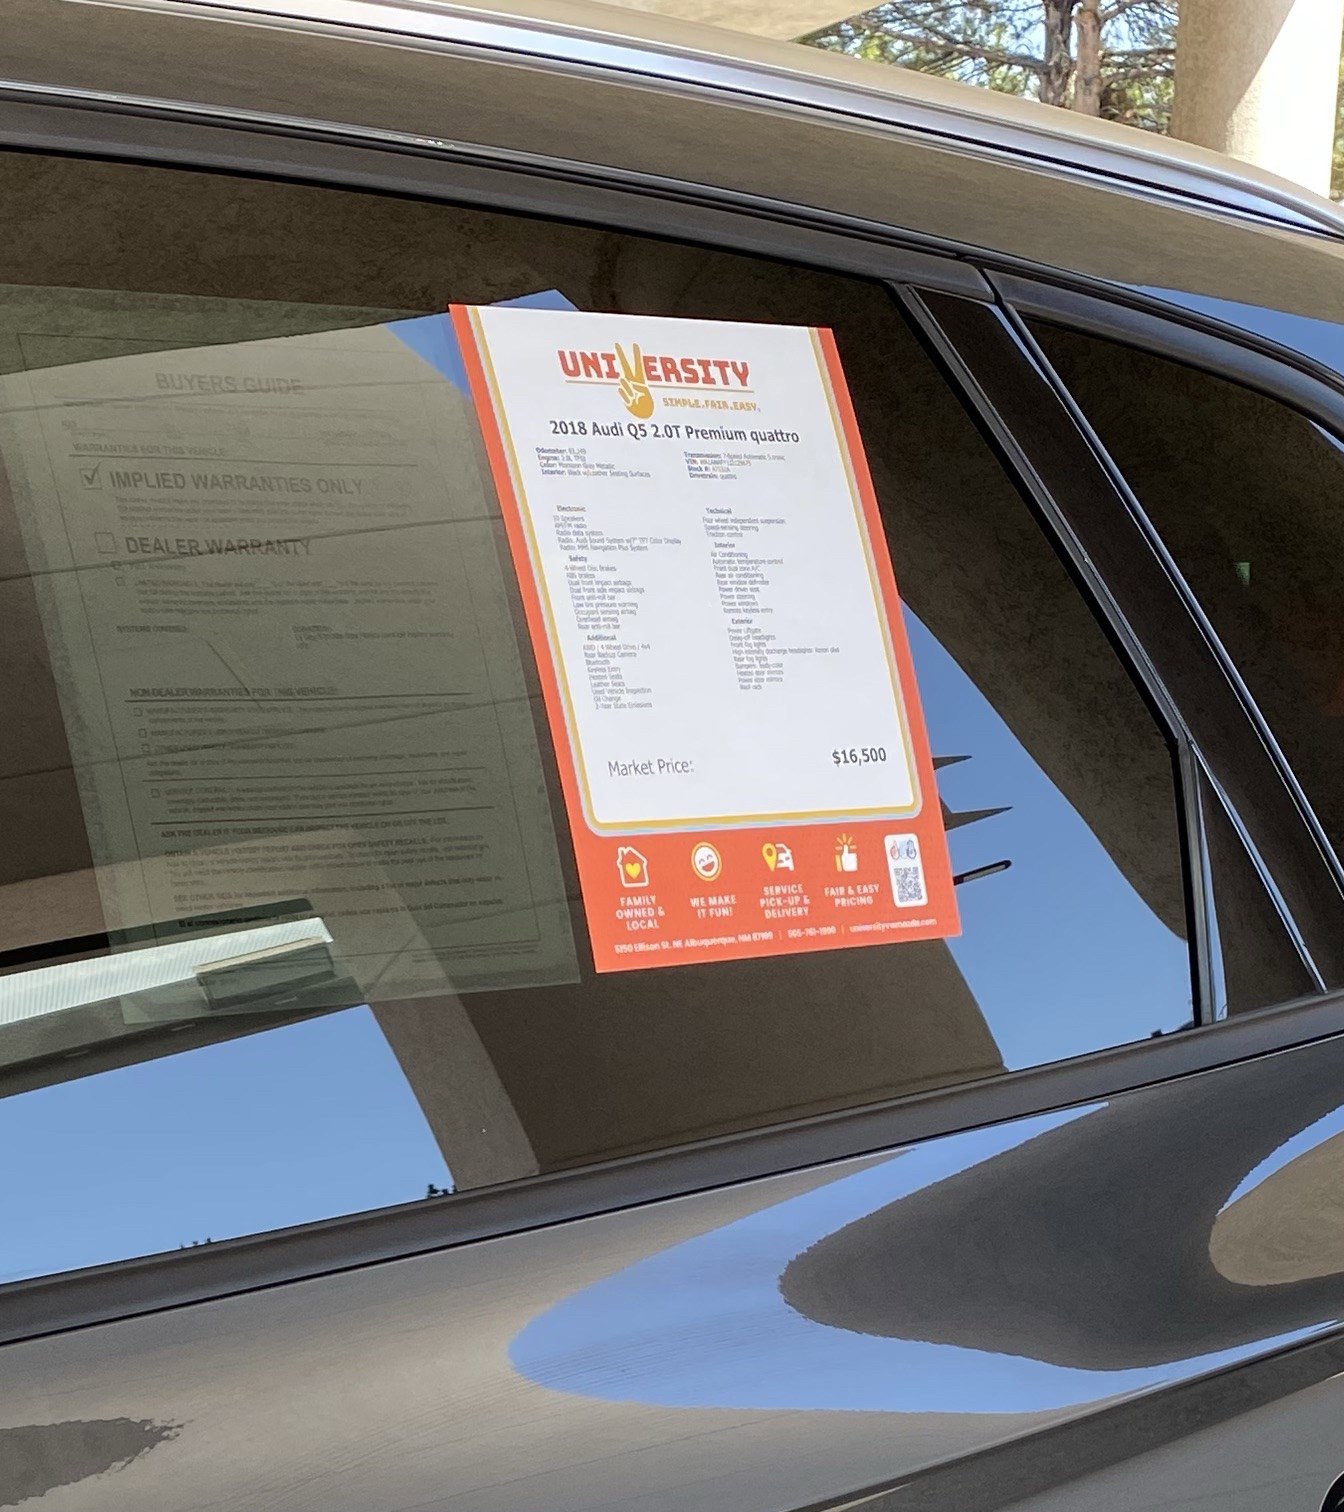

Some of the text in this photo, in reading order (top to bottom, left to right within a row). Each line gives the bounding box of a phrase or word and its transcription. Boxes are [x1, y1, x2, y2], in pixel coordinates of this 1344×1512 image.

[557, 343, 749, 387] UNIVERSITY
[156, 372, 304, 395] BUYERS GUIDE
[549, 420, 799, 445] 2018 Audi Q5 2.0T Premium quattro
[110, 471, 364, 495] IMPLIED WARRANTIES ONLY
[125, 536, 311, 556] DEALER WARRANTY
[607, 747, 887, 777] Market Price: $16,500
[763, 884, 804, 896] SERVICE
[824, 884, 879, 897] FAIR & EASY
[619, 895, 656, 907] FAMILY
[690, 895, 737, 907] WE MAKE
[759, 895, 811, 908] PICK-UP &
[834, 896, 873, 908] PRICING
[616, 906, 665, 919] OWNED &
[697, 906, 733, 919] IT FUN!
[764, 907, 809, 919] DELIVERY
[626, 919, 659, 931] LOCAL
[614, 944, 633, 954] 5150
[634, 943, 660, 952] Ellison
[738, 933, 752, 943] NM
